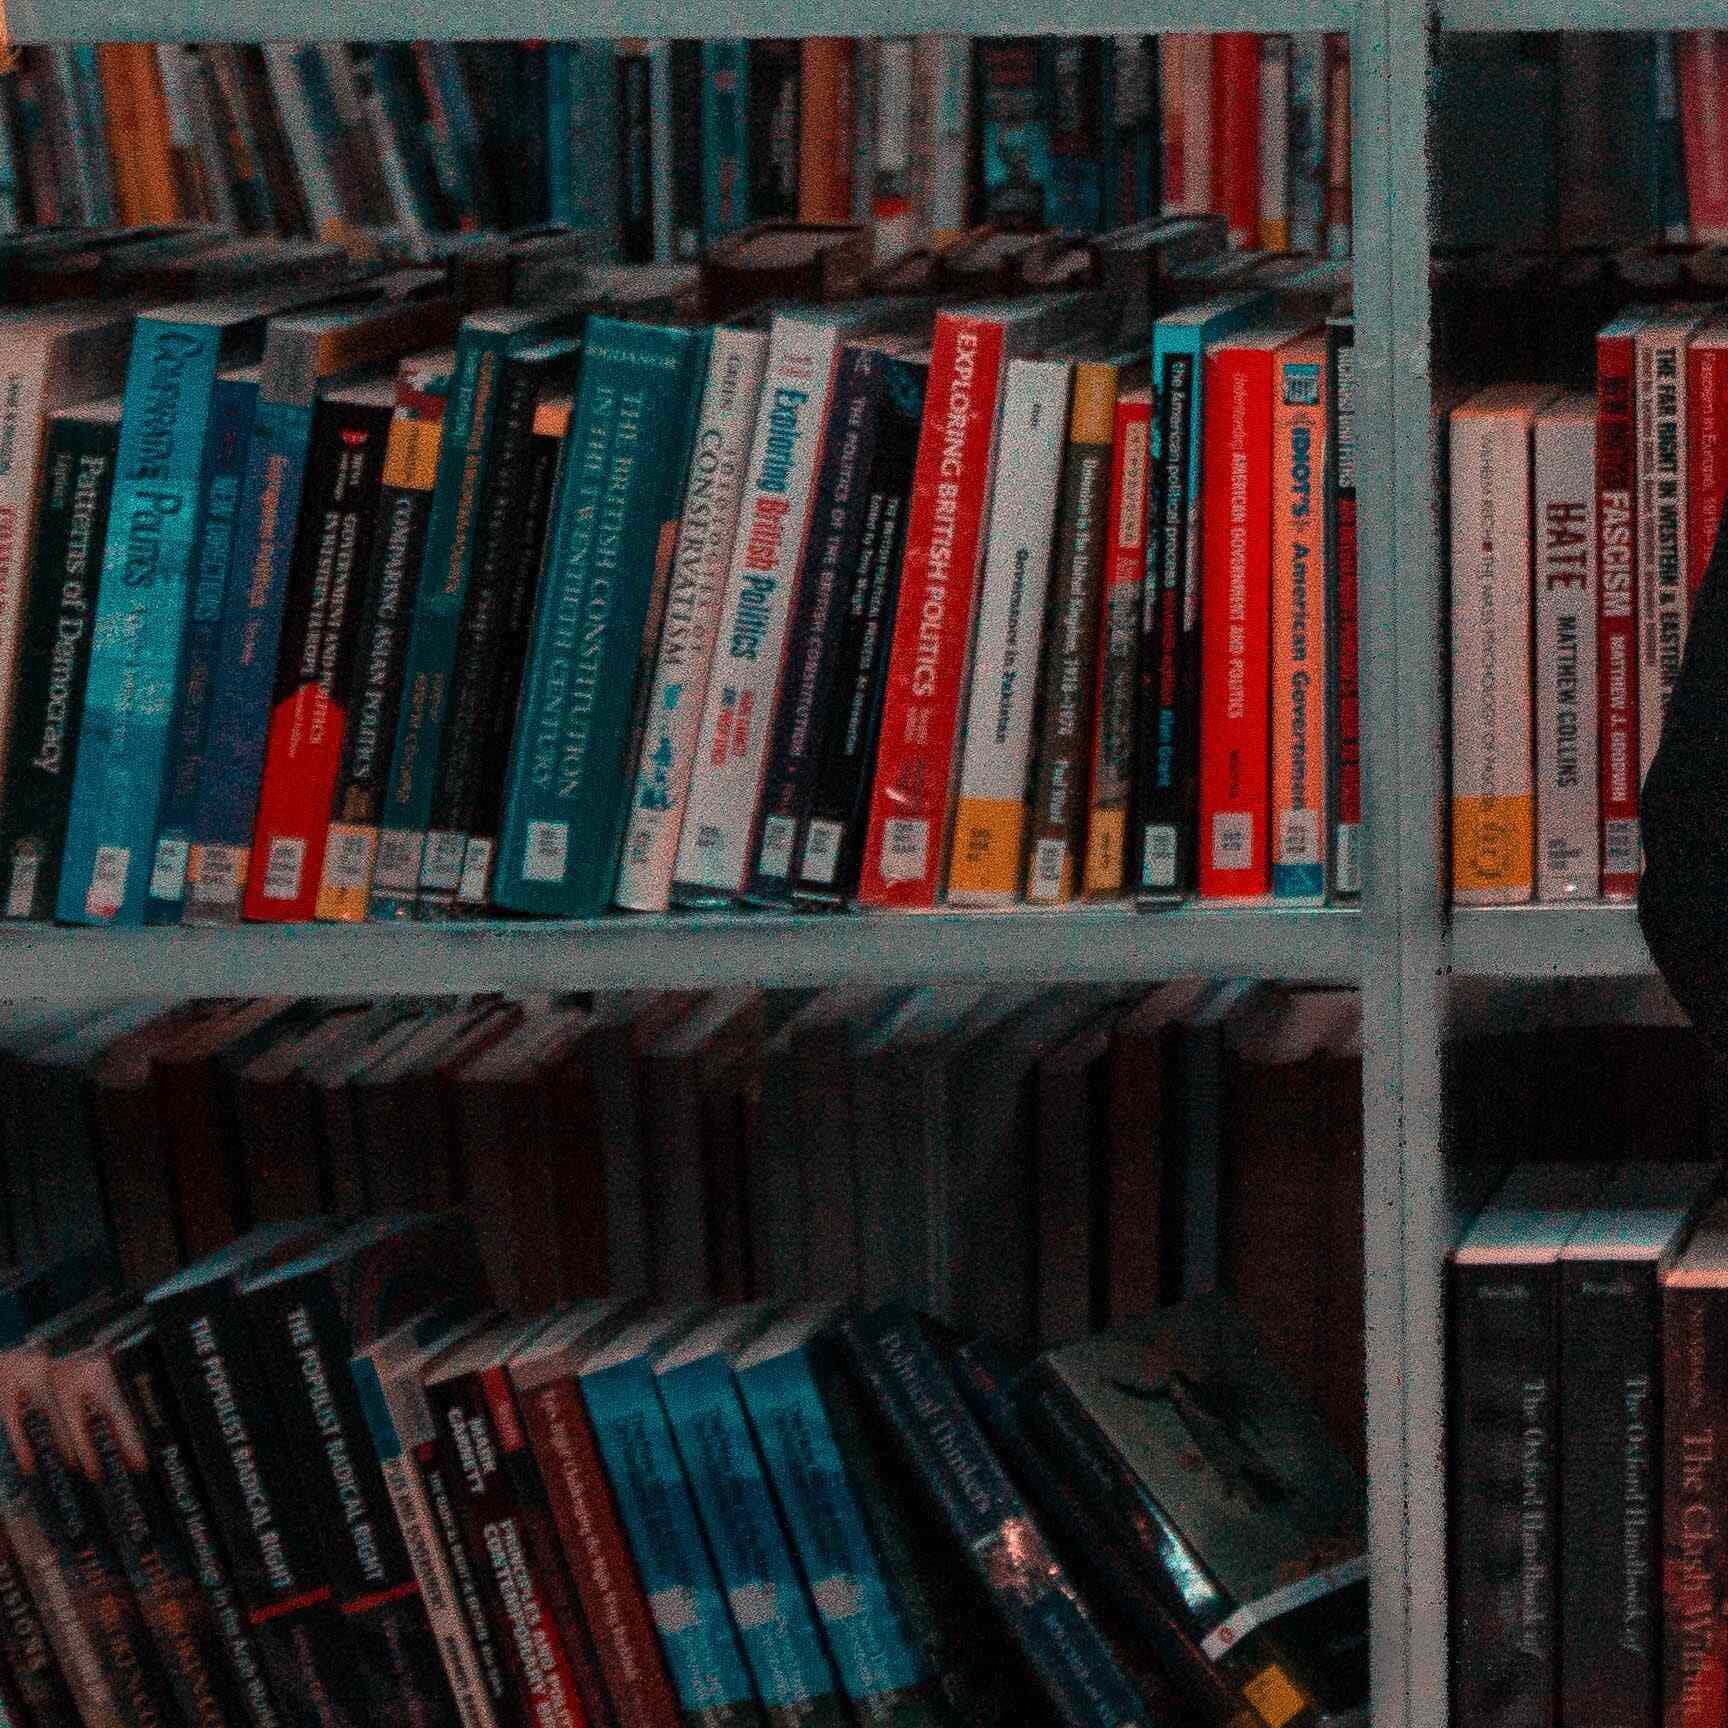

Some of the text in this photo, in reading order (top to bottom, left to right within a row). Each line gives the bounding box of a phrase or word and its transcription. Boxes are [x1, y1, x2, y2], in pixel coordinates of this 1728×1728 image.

[662, 429, 724, 665] CONSERVATISM
[730, 389, 808, 661] Exploring British Politics
[912, 333, 977, 696] EXPLORING BRITISH POLITICS
[1161, 362, 1186, 587] the American political process
[34, 454, 104, 774] Patterns of Democracy
[1547, 502, 1586, 787] HATE MATTHEW COLLINS
[1602, 491, 1631, 802] FASCISM MATTHEW J. GOODWIN
[286, 1308, 384, 1581] THE POPULIST RADICAL RIGHT
[447, 1407, 484, 1493] GARNETT
[467, 1419, 497, 1474] MARK
[1682, 1427, 1712, 1717] The Clash Within
